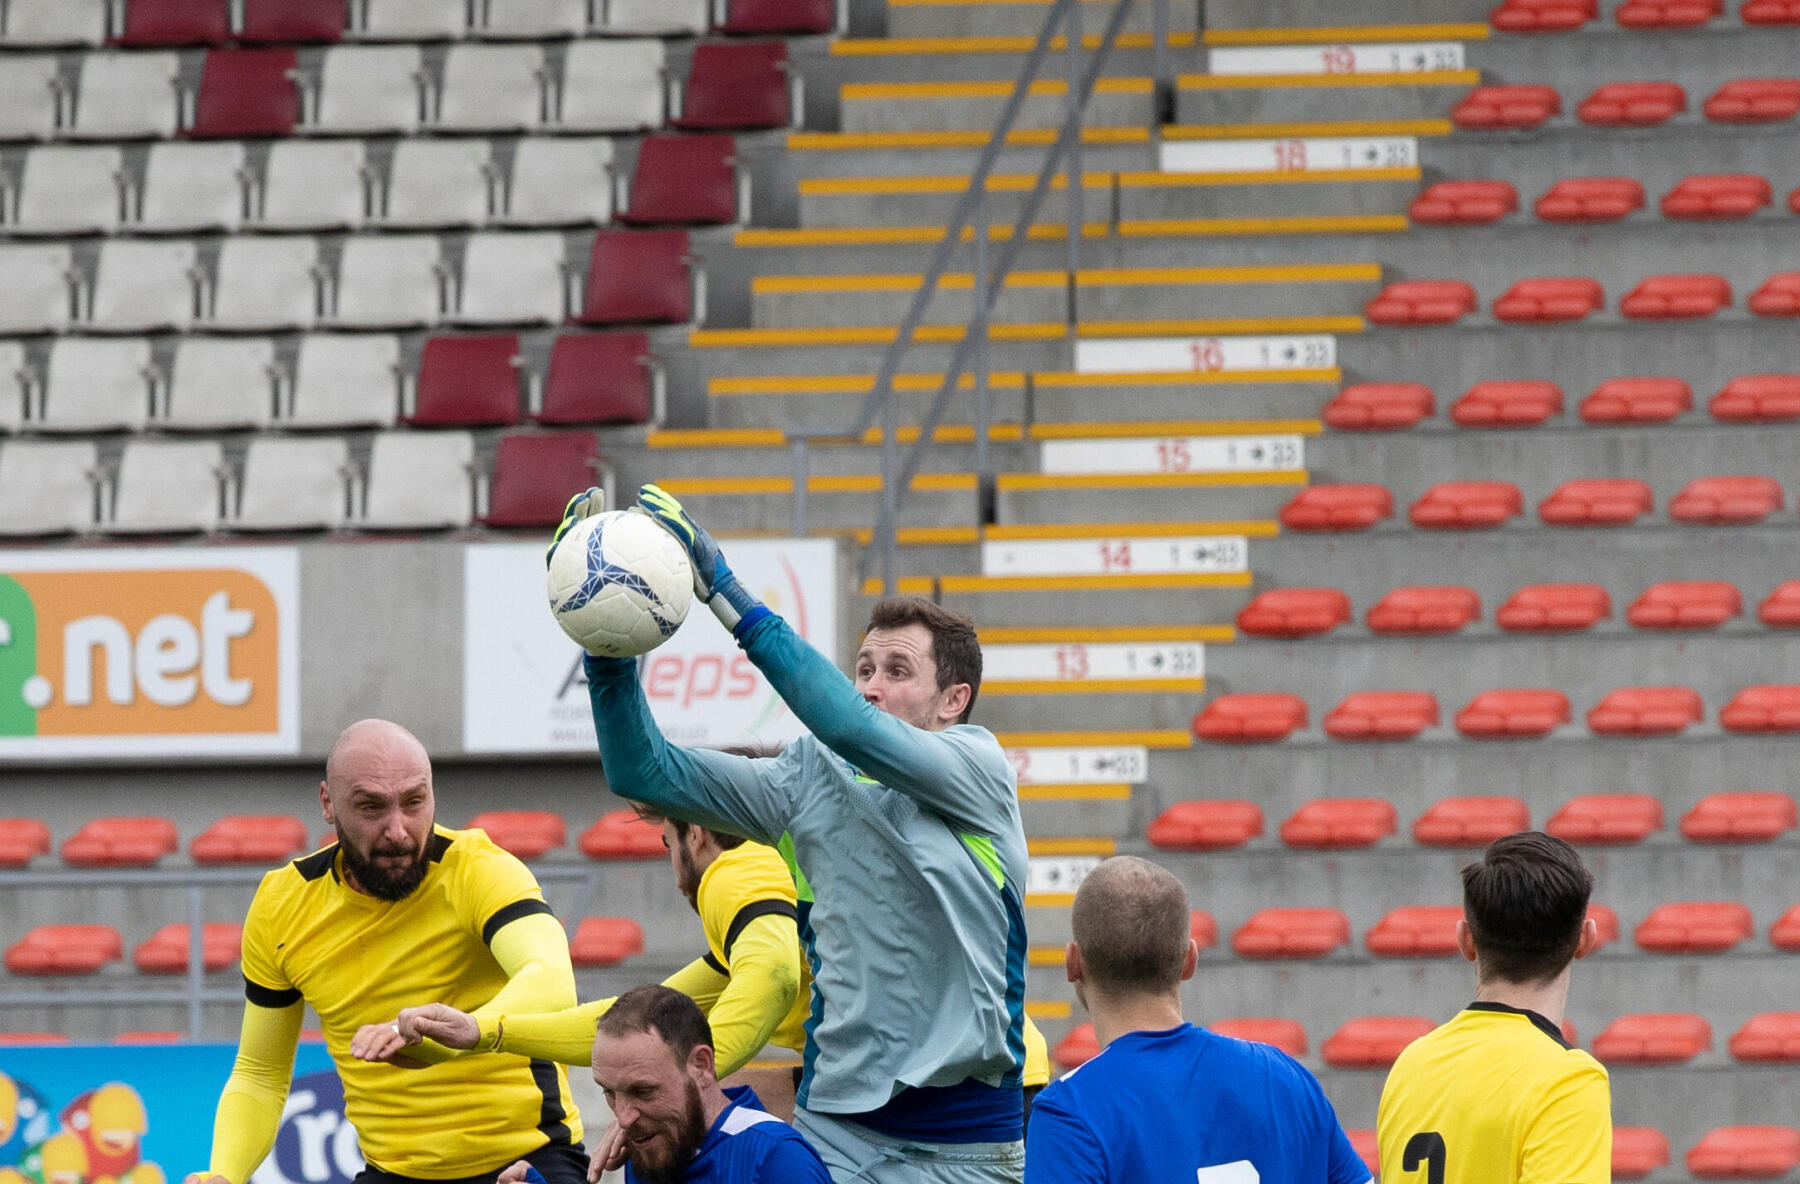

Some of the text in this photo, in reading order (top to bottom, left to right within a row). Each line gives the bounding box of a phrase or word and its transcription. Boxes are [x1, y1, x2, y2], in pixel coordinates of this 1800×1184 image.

[1321, 47, 1356, 74] 19
[1274, 141, 1307, 171] 18
[1190, 340, 1225, 372] 16
[1157, 440, 1191, 473] 15
[1100, 541, 1132, 573] 14
[0, 589, 255, 708] .net
[1056, 645, 1089, 680] 13
[1003, 751, 1031, 784] 2
